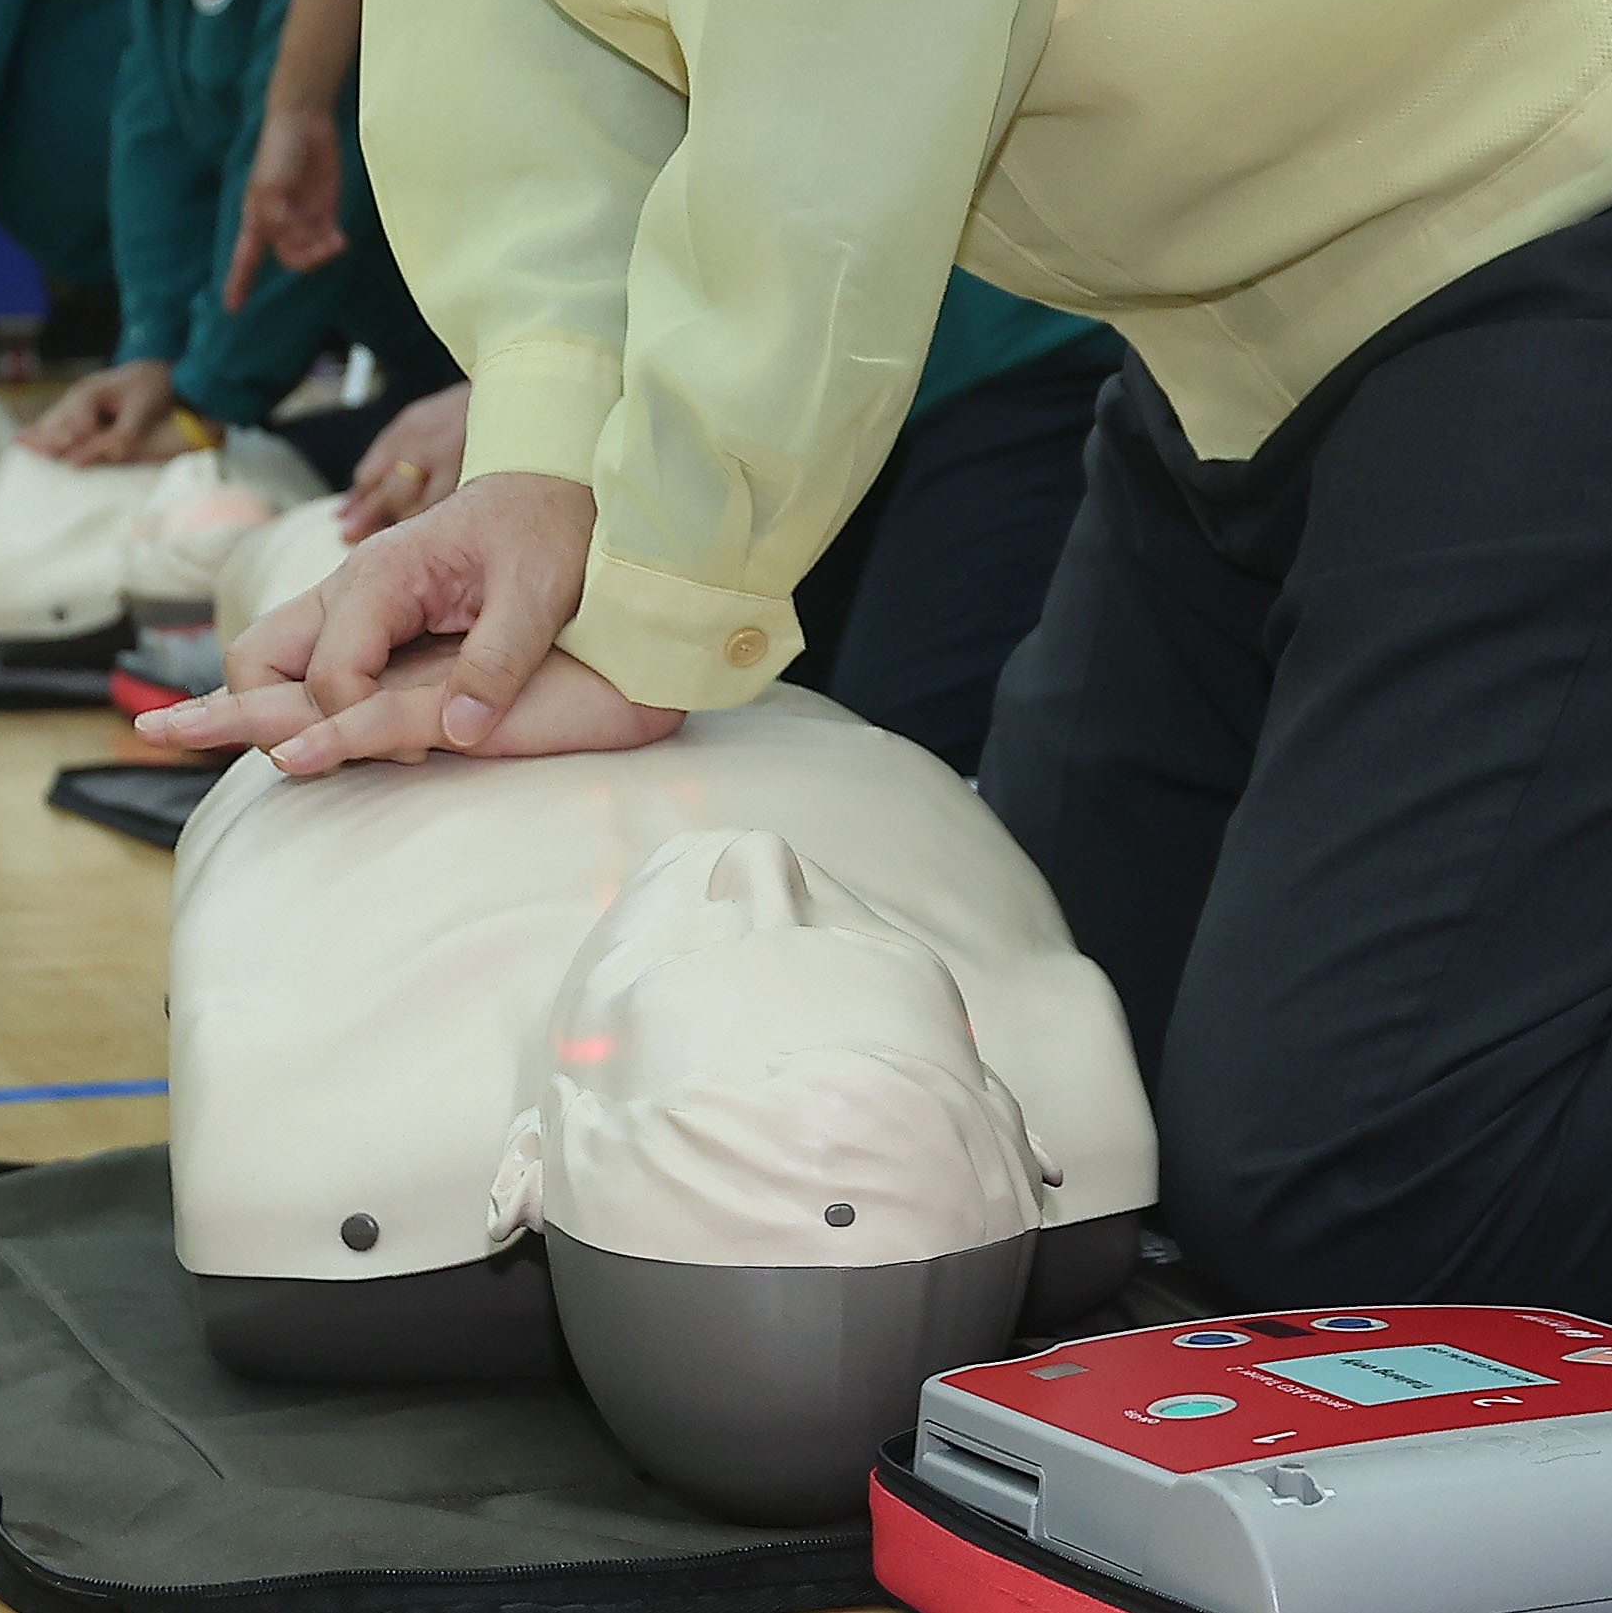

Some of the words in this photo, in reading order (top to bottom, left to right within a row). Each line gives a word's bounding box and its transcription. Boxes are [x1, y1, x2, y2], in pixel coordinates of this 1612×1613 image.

[1339, 1358, 1379, 1369] only
[1371, 1368, 1433, 1389] Training
[1275, 1383, 1310, 1395] AED
[1472, 1395, 1524, 1407] 2
[1252, 1430, 1298, 1444] 1
